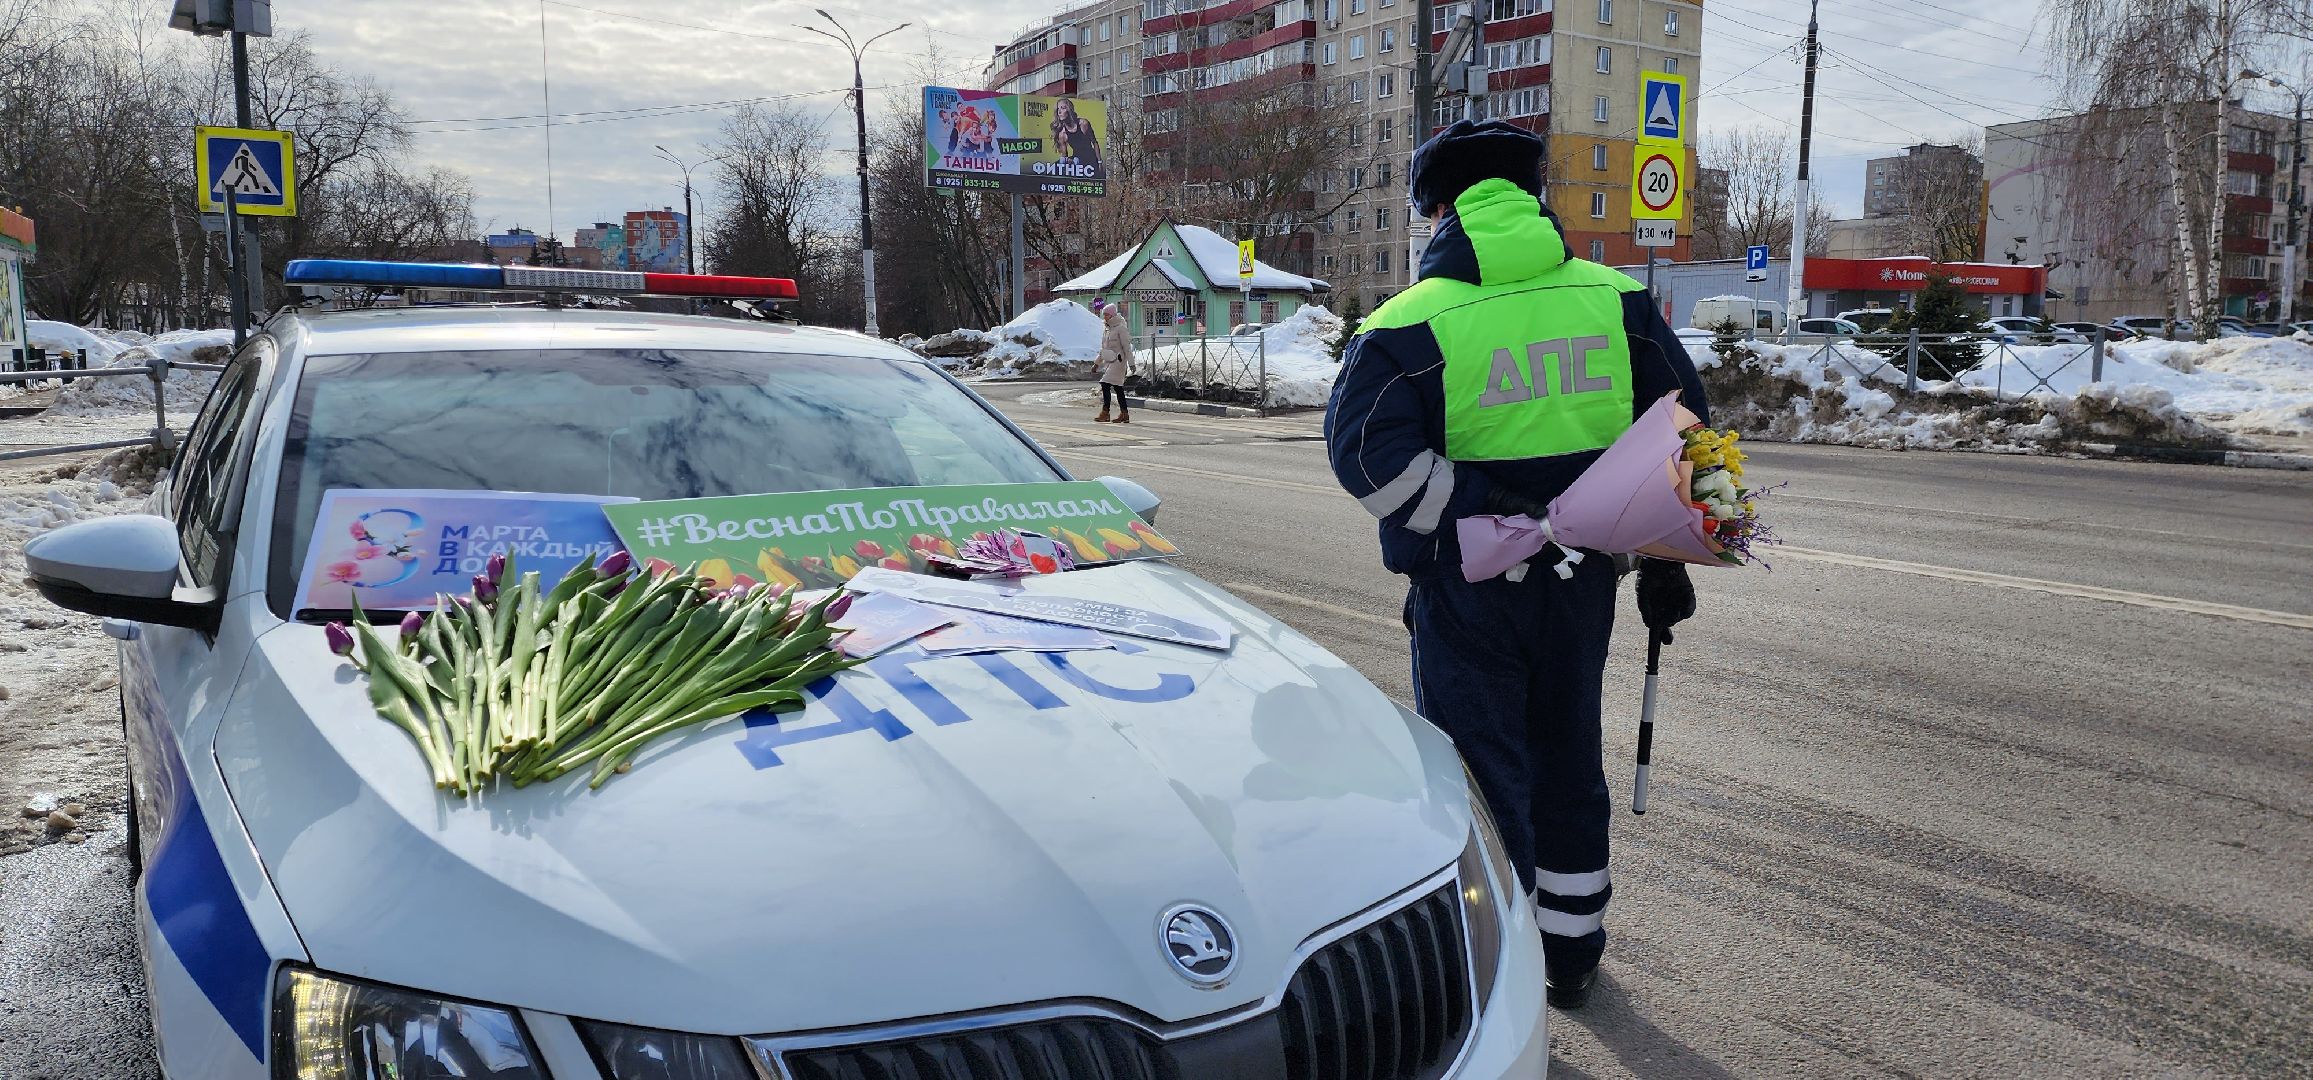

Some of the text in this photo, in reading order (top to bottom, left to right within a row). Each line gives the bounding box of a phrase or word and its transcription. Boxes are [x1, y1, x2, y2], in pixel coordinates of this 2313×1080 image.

[1002, 142, 1037, 153] НАБОР
[944, 155, 999, 171] ТАНЦЫ
[1033, 161, 1095, 177] ФИТНЕС
[936, 177, 999, 188] 8 (925) 833-11-25
[1048, 184, 1065, 193] (925)
[1648, 172, 1669, 193] 20
[1645, 228, 1655, 238] 30
[1140, 293, 1176, 302] OZON
[1479, 335, 1612, 408] ДПС
[637, 496, 1122, 547] #ВеснаПоПравилам
[441, 525, 550, 541] МАРТА
[439, 541, 615, 559] В КАЖДЫЙ
[432, 558, 488, 576] ДО
[734, 639, 1195, 770] ДПС
